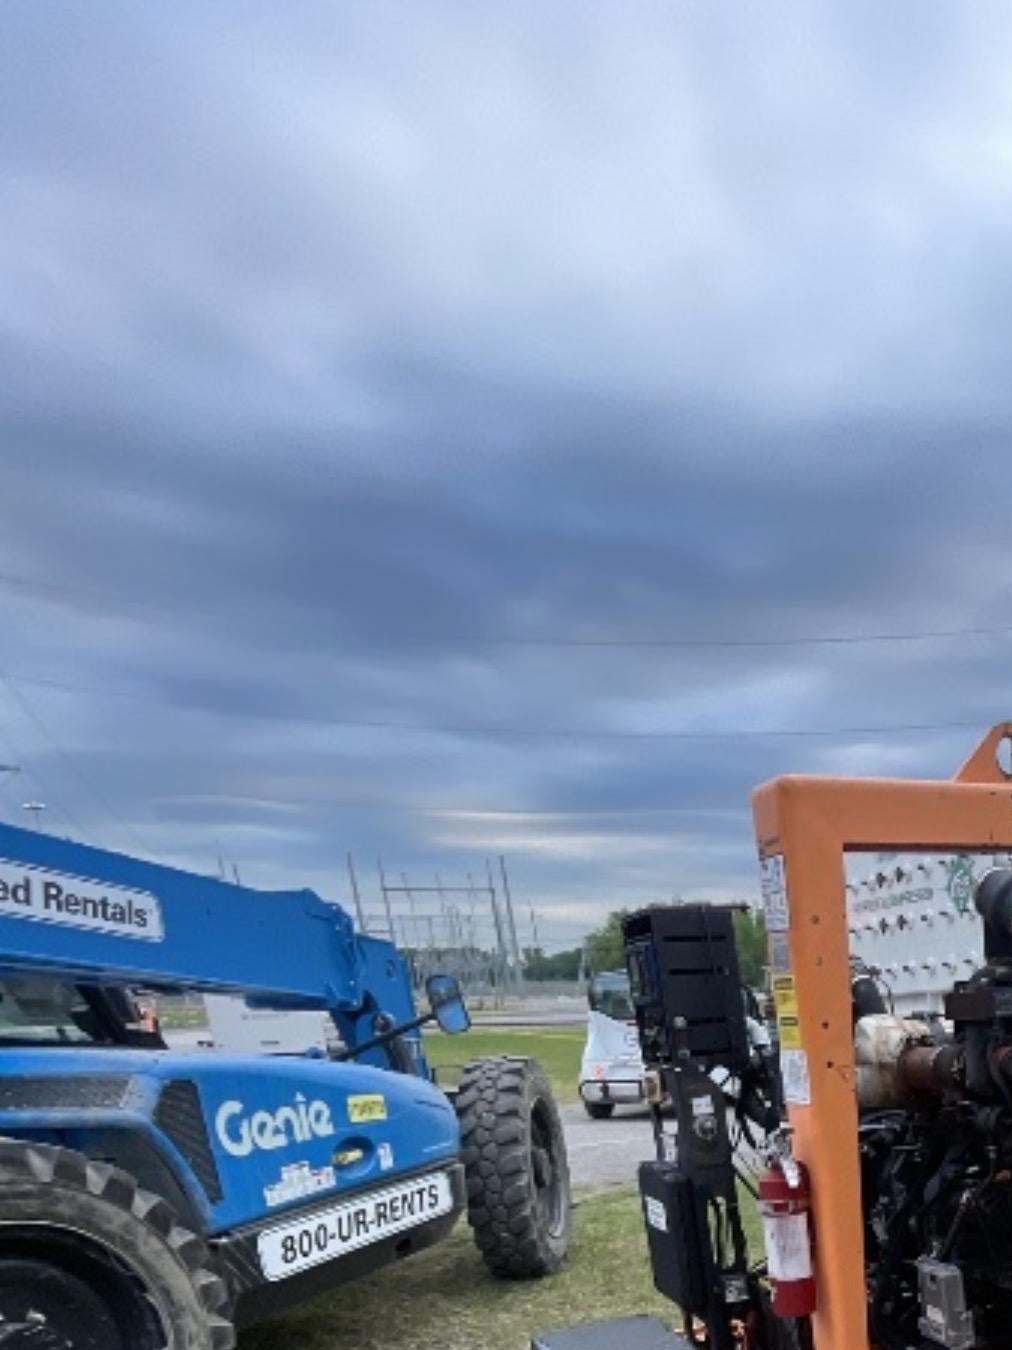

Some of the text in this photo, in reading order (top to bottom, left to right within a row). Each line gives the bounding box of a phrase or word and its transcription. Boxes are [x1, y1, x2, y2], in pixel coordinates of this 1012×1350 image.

[44, 882, 147, 928] Rentals
[215, 1092, 334, 1156] Genie
[281, 1185, 439, 1264] 800-UR-RENTS
